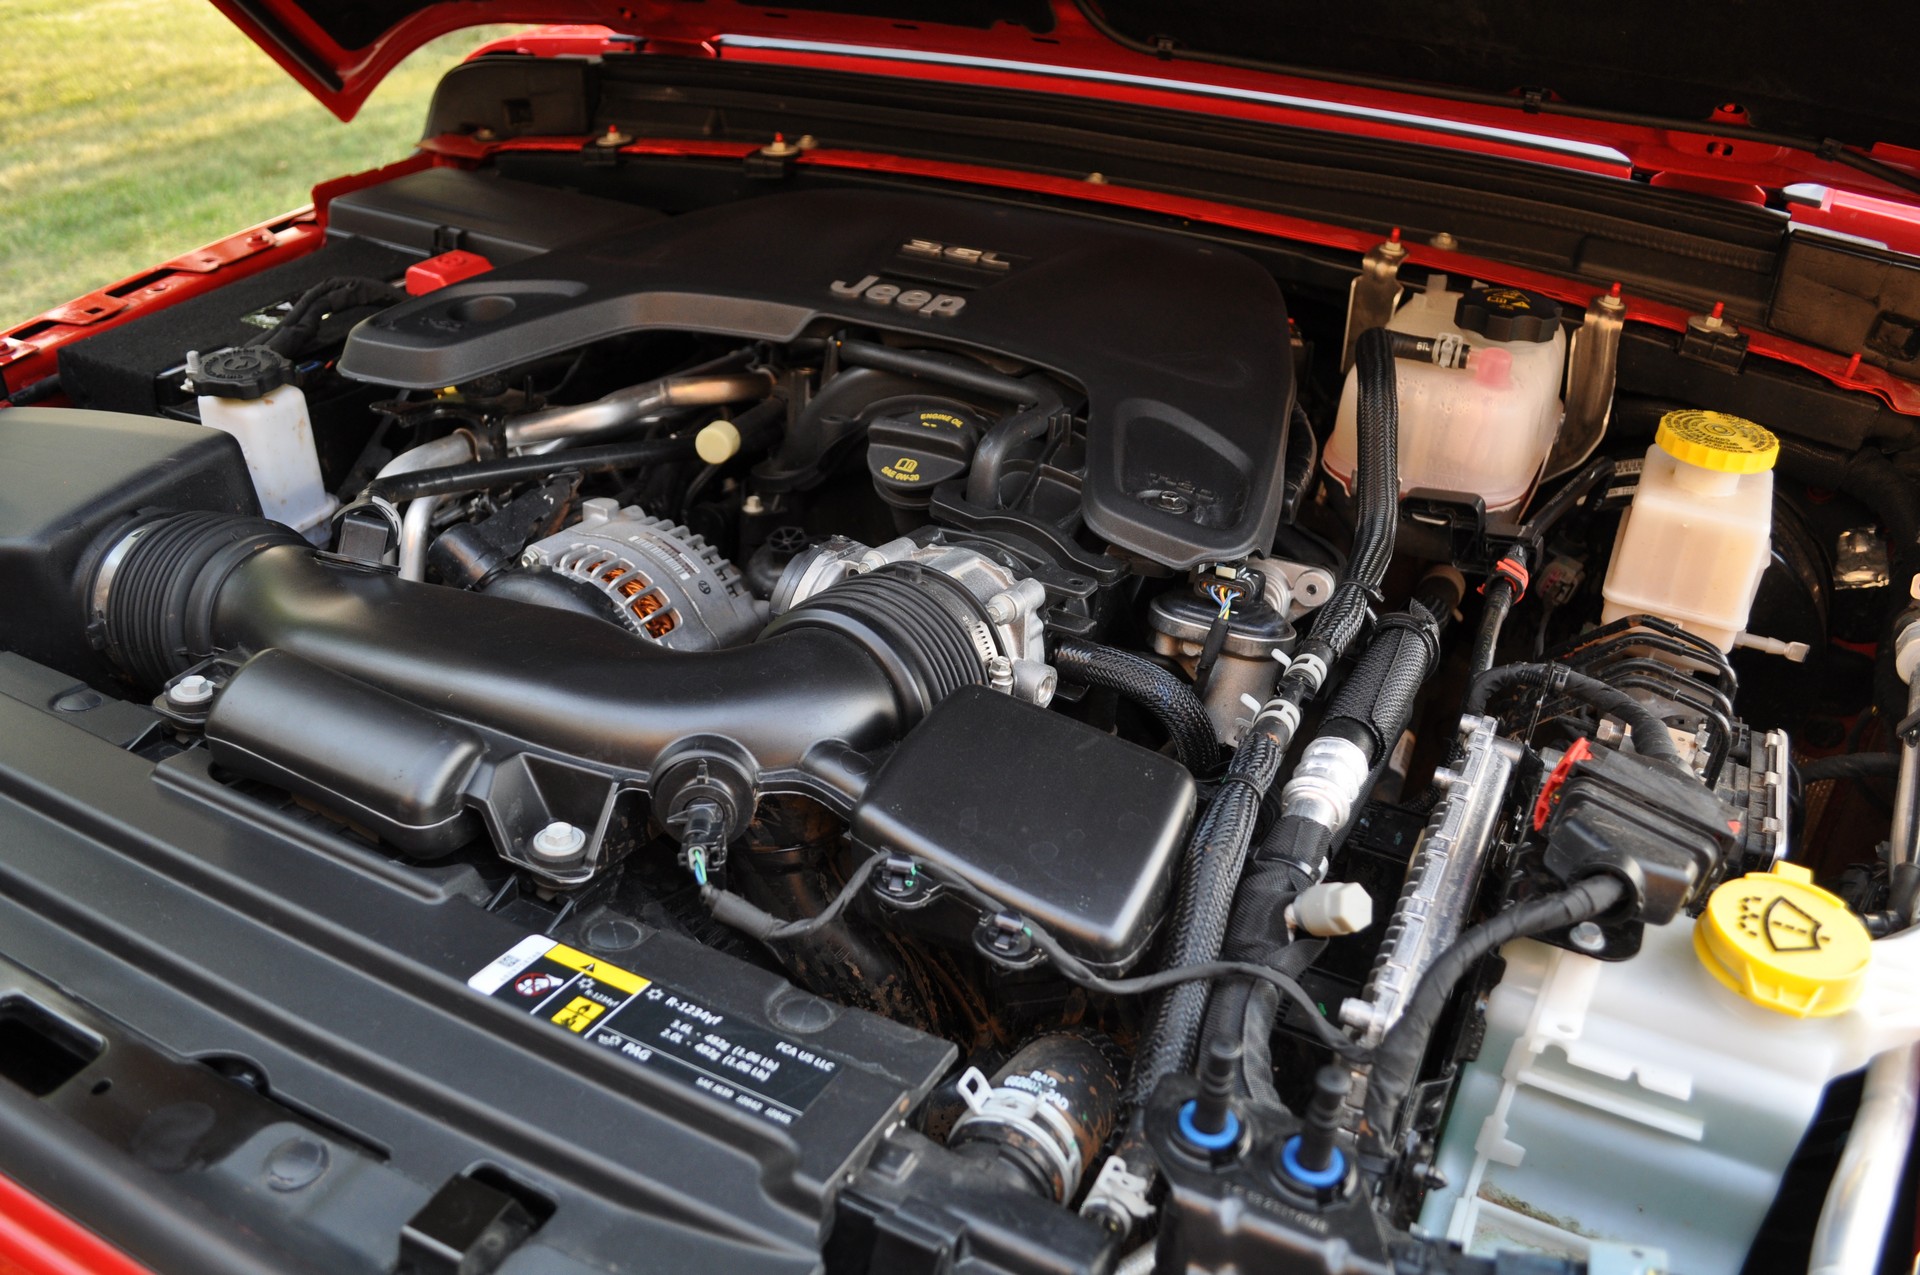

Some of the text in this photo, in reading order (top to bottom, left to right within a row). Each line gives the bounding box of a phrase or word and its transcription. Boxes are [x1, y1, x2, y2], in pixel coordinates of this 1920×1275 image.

[830, 275, 967, 317] Jeep
[665, 996, 723, 1026] R-1234yf
[660, 1028, 683, 1044] 2.0L
[670, 1019, 694, 1035] 3.6L
[622, 1042, 653, 1061] PAG
[775, 1041, 835, 1072] FCA US LLC
